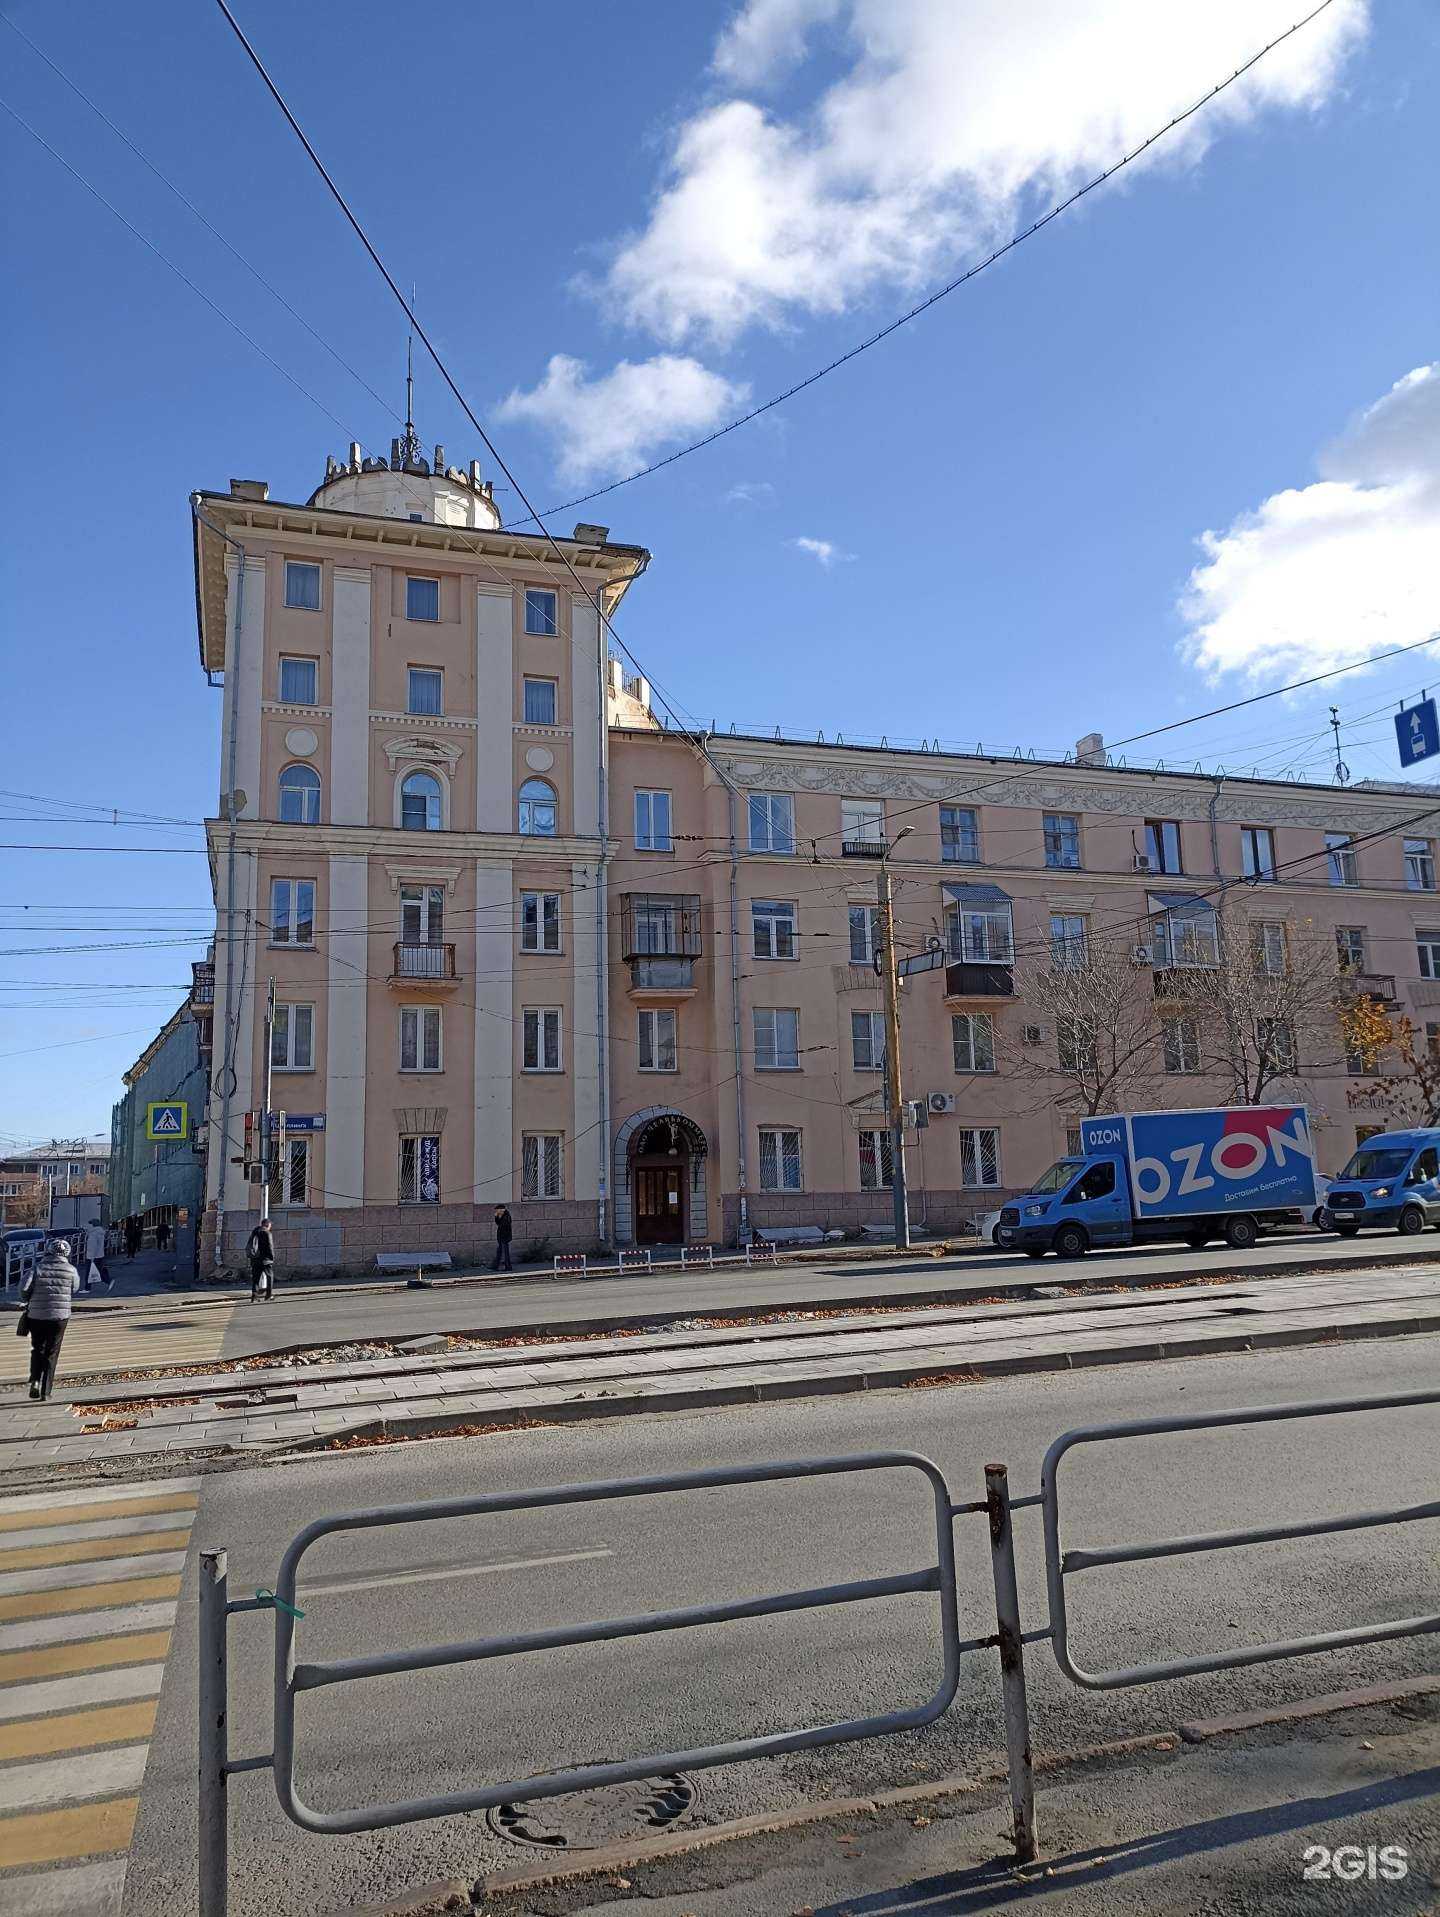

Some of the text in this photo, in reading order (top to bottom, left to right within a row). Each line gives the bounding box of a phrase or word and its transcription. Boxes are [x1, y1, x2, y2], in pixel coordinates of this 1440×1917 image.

[1089, 1128, 1121, 1146] OZON
[1133, 1117, 1312, 1204] OZON
[1224, 1175, 1297, 1202] Доставим бесплатно
